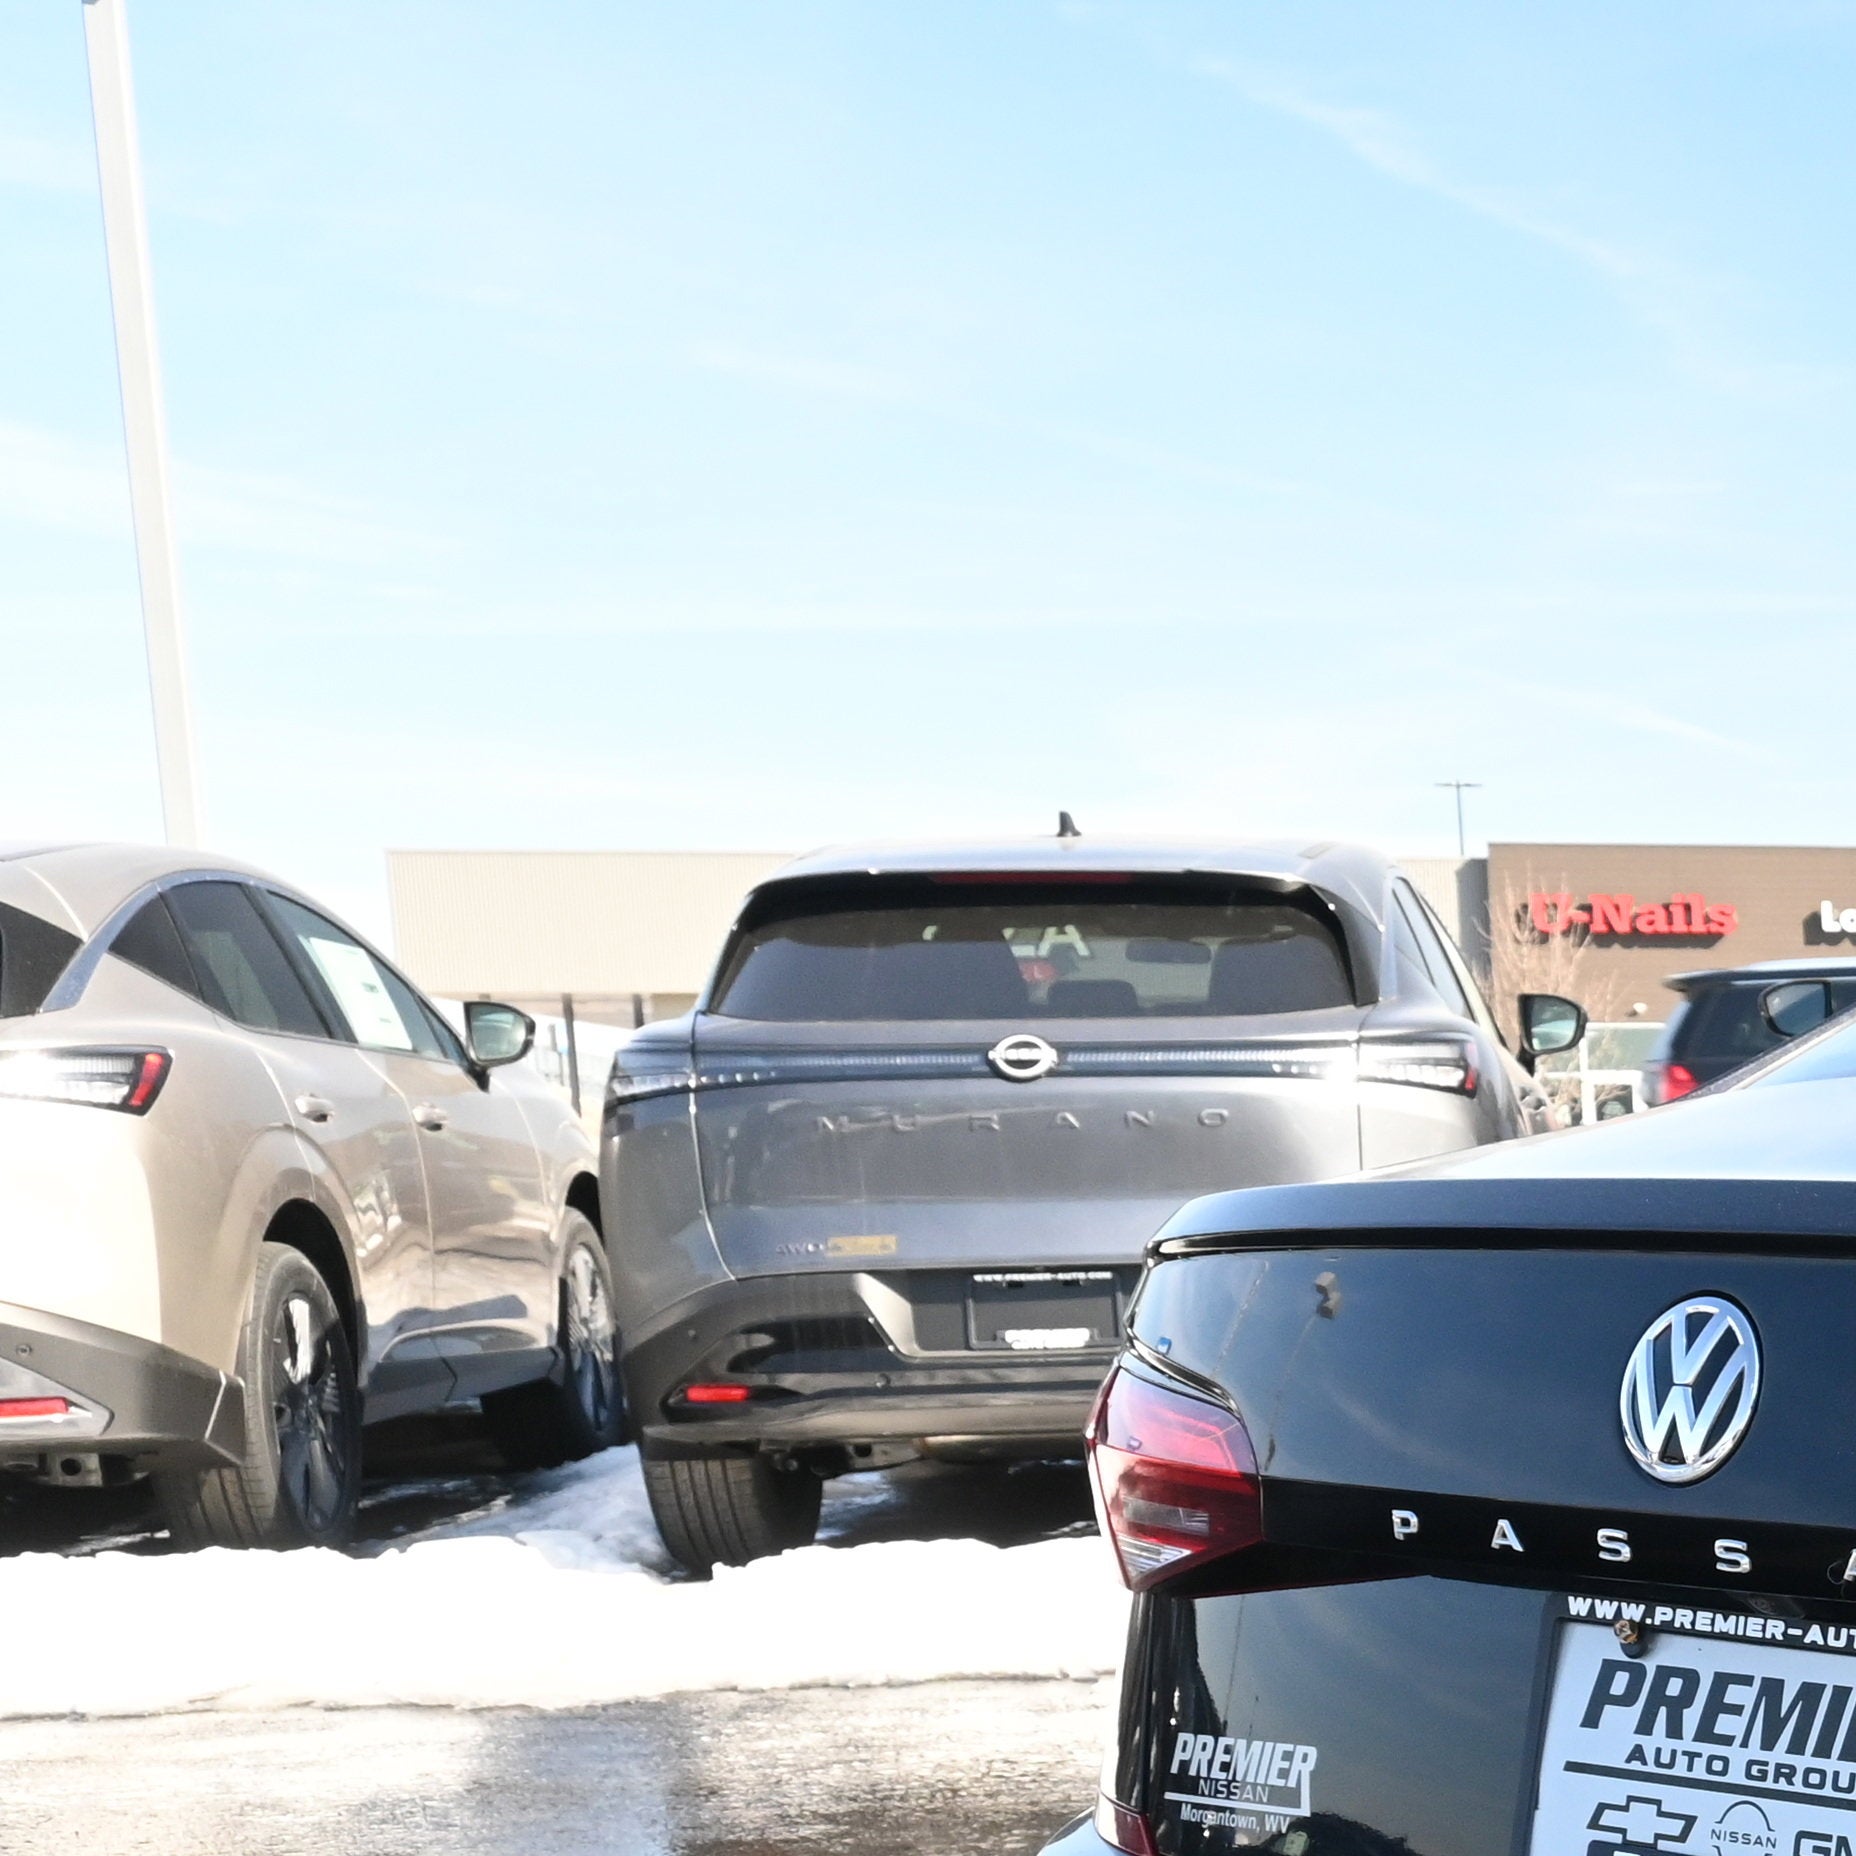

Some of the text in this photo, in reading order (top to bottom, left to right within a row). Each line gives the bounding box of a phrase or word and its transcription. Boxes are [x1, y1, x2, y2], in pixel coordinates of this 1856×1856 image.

[1530, 892, 1738, 935] U-Nails
[816, 1107, 1229, 1133] MURANO
[1170, 1732, 1317, 1795] PREMIER
[1624, 1743, 1730, 1777] AUTO
[1198, 1778, 1269, 1803] NISSAN
[1180, 1803, 1290, 1834] Morgantown, WV
[1710, 1828, 1778, 1850] NISSAN
